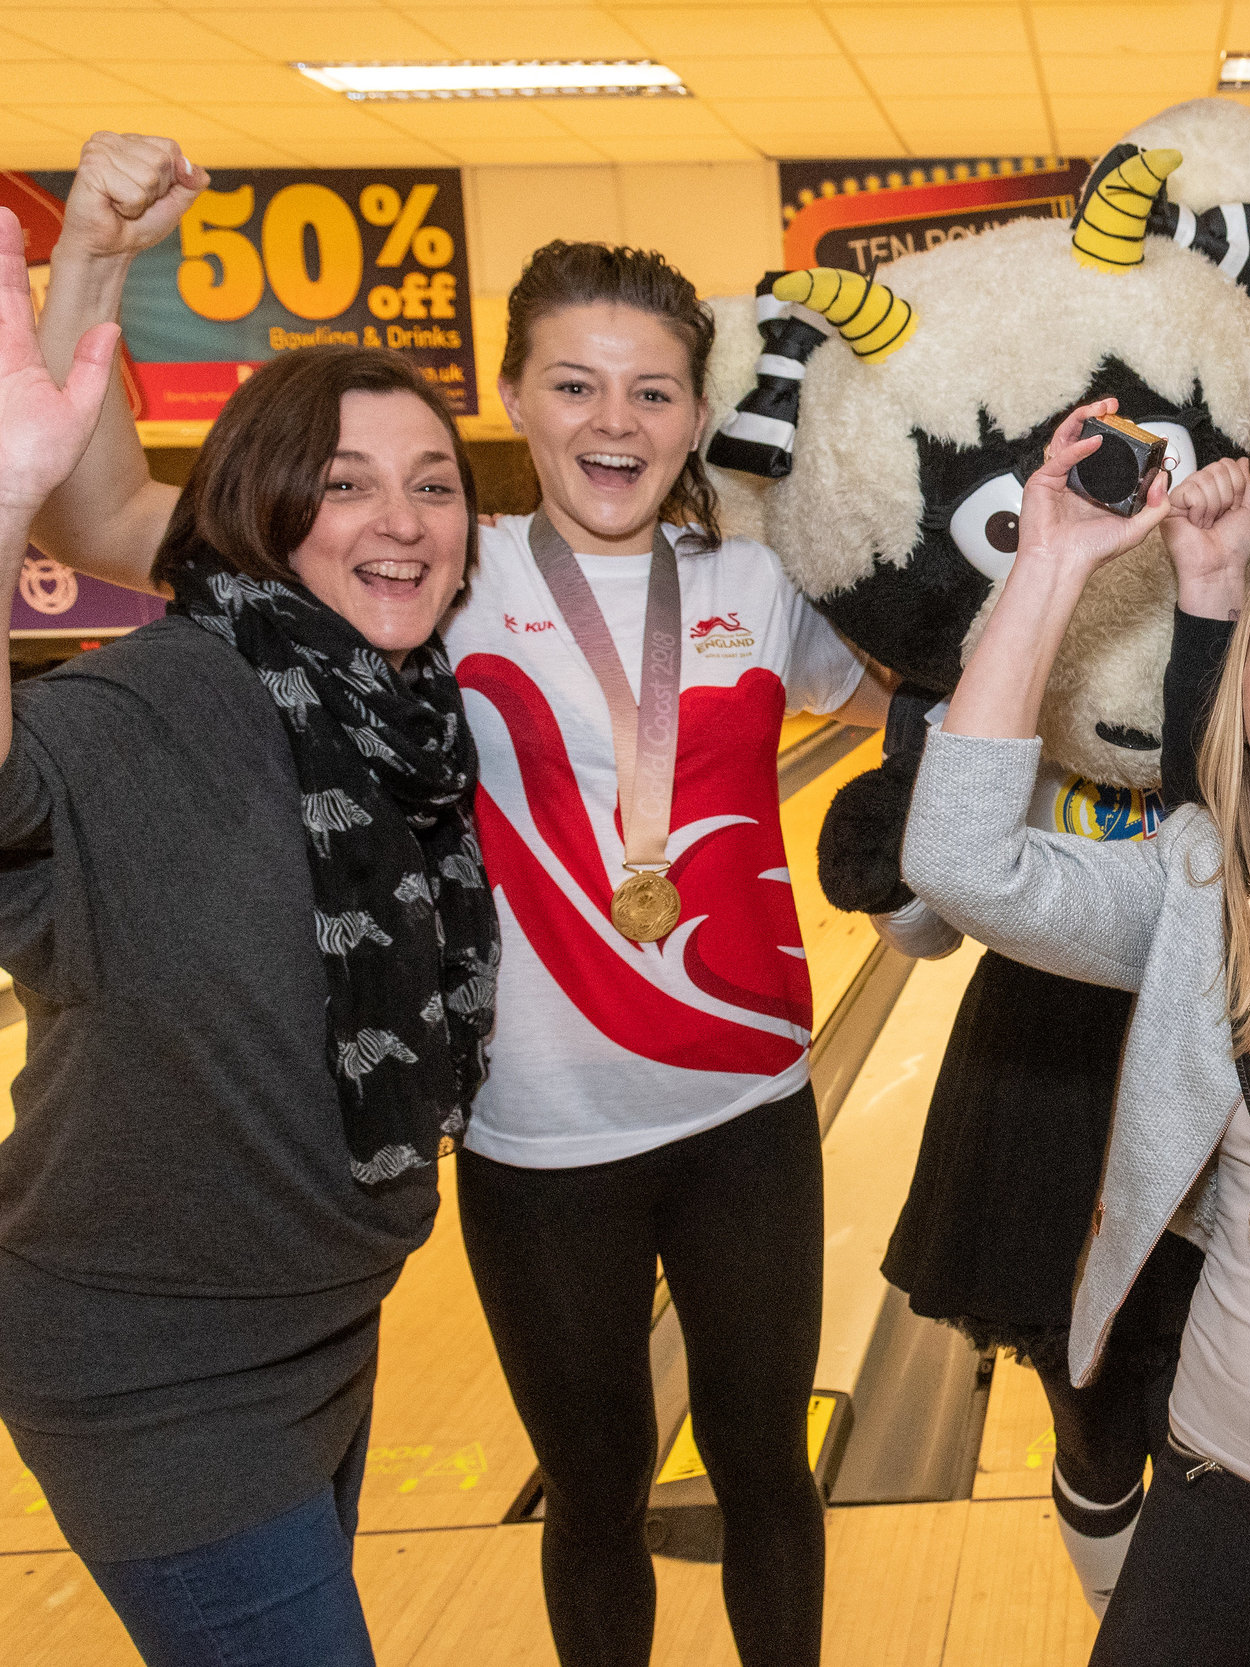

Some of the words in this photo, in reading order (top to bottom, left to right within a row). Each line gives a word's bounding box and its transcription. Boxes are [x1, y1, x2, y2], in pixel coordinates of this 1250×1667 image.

[177, 183, 454, 322] 50%
[367, 272, 457, 320] off
[269, 326, 359, 350] Bowling
[363, 325, 382, 347] &
[386, 325, 462, 349] Drinks
[650, 630, 676, 677] 2018
[694, 638, 755, 654] ENGLAND
[644, 677, 673, 746] Coast
[637, 749, 669, 820] Gold
